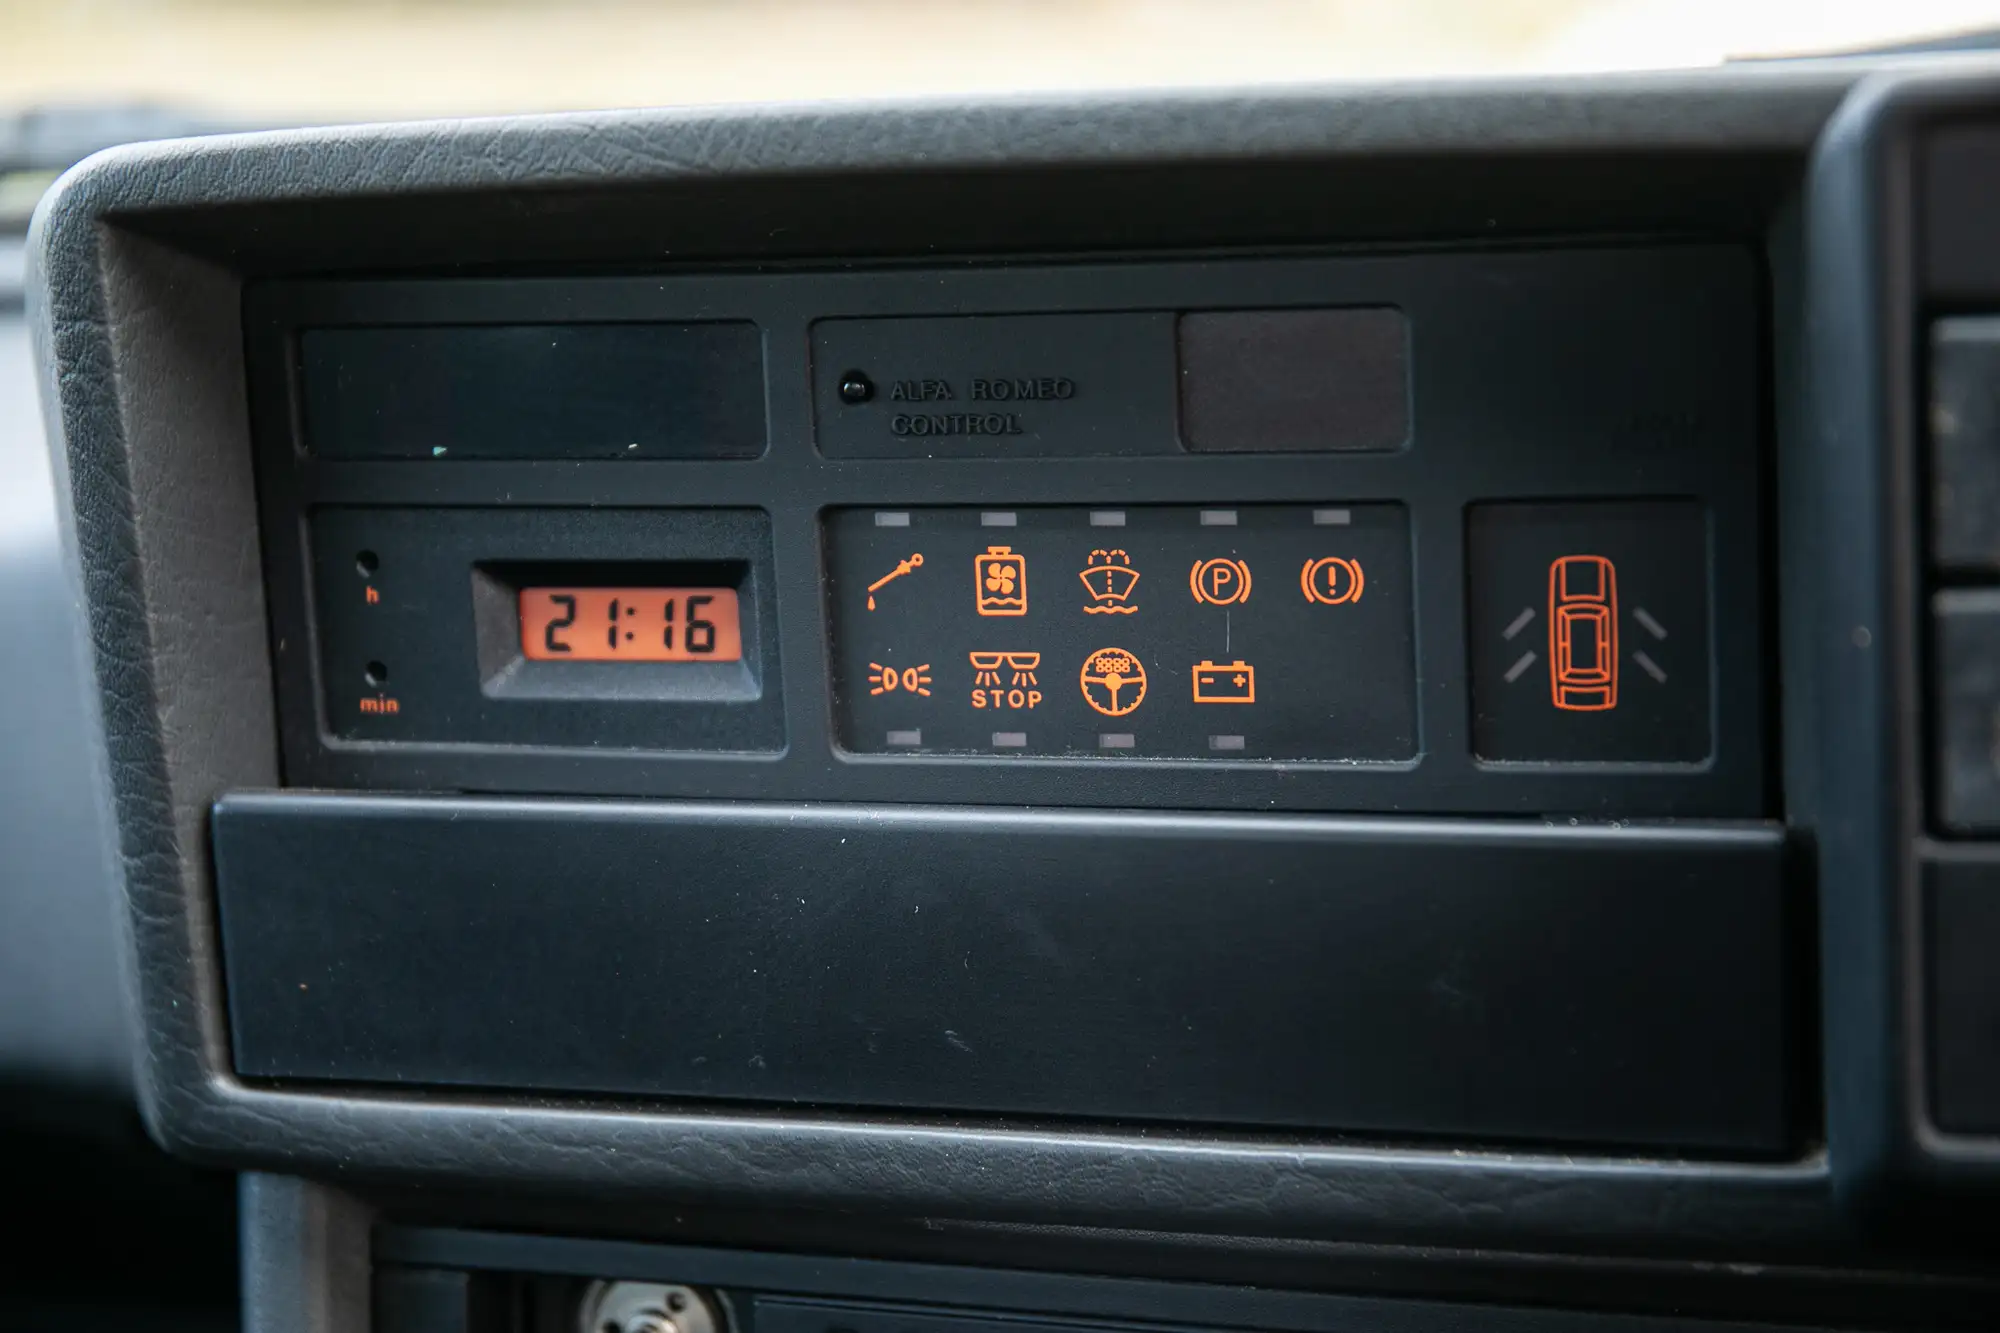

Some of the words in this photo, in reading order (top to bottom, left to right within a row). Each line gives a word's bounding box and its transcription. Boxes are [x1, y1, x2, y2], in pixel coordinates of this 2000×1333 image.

[890, 380, 952, 401] ALFA
[970, 379, 1076, 401] ROMEO
[890, 413, 1023, 436] CONTROL
[1212, 568, 1232, 596] P
[366, 587, 379, 604] h
[544, 595, 716, 653] 21:16
[360, 693, 399, 713] min
[971, 689, 1042, 709] STOP
